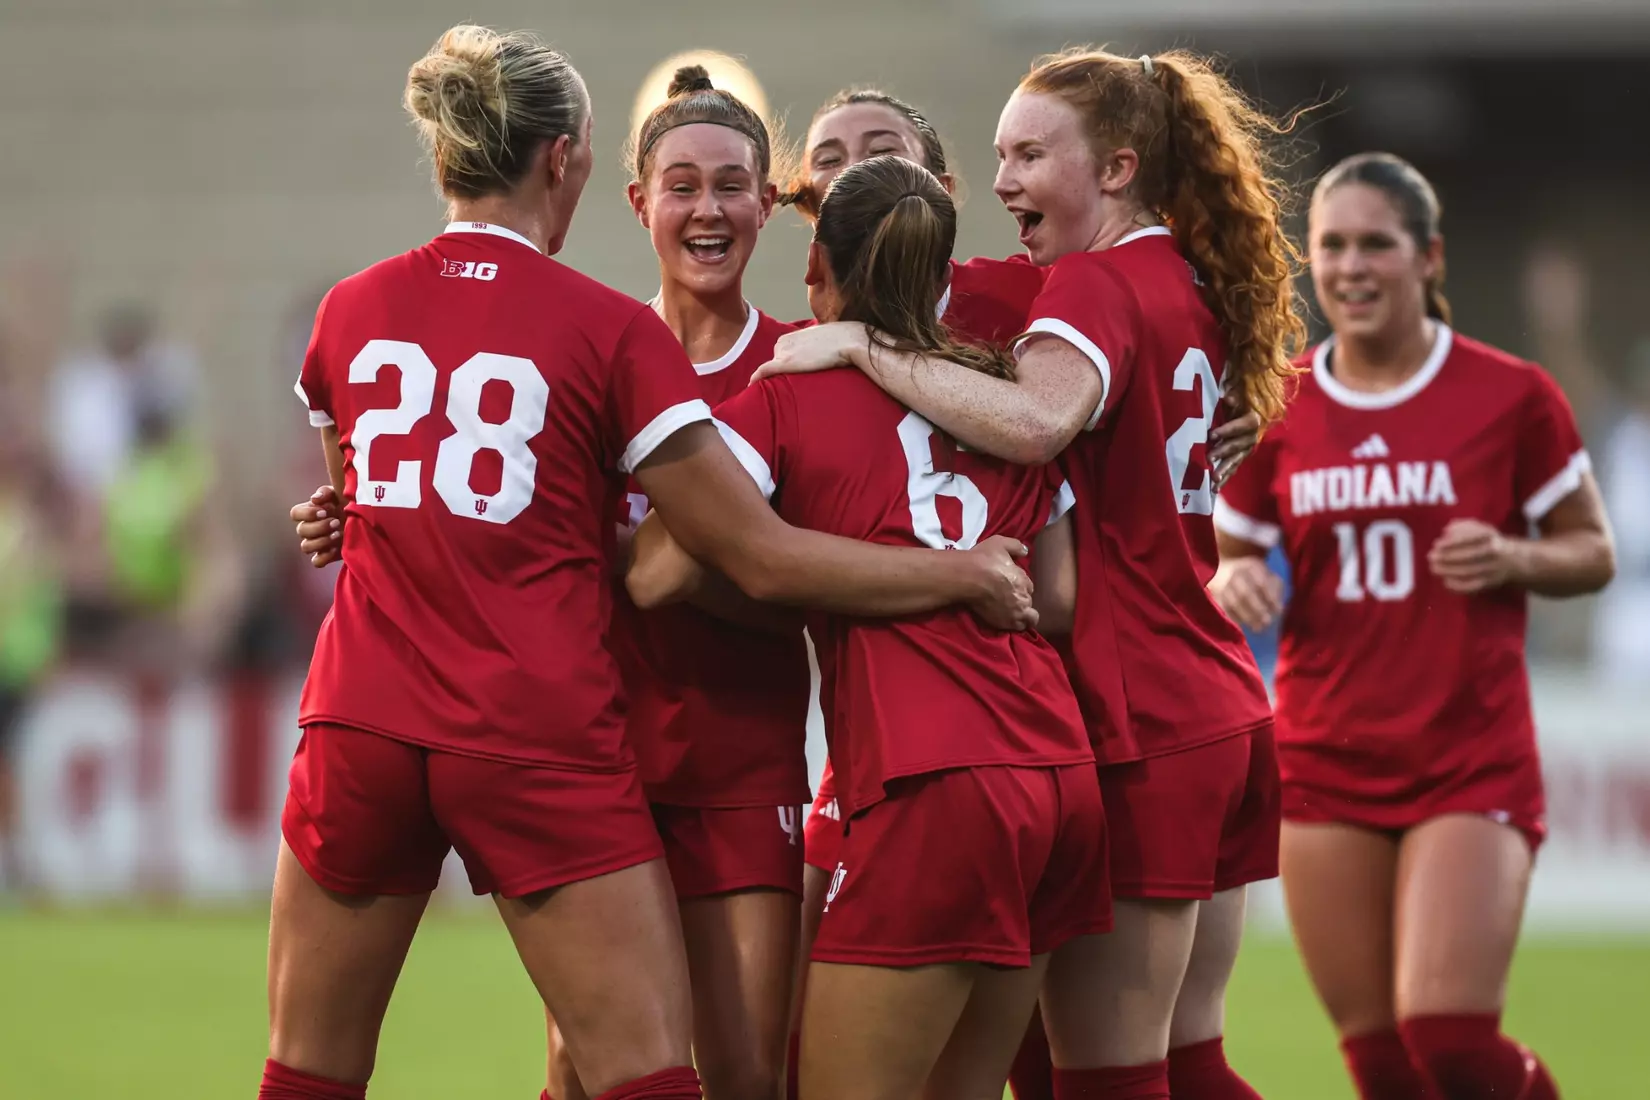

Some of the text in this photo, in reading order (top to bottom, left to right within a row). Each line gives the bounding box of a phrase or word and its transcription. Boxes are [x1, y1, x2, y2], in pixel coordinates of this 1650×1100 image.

[471, 222, 487, 230] 1993
[348, 339, 550, 525] 28
[896, 410, 989, 550] 6
[1165, 346, 1226, 516] 2
[1290, 460, 1457, 518] INDIANA
[1332, 518, 1415, 602] 10
